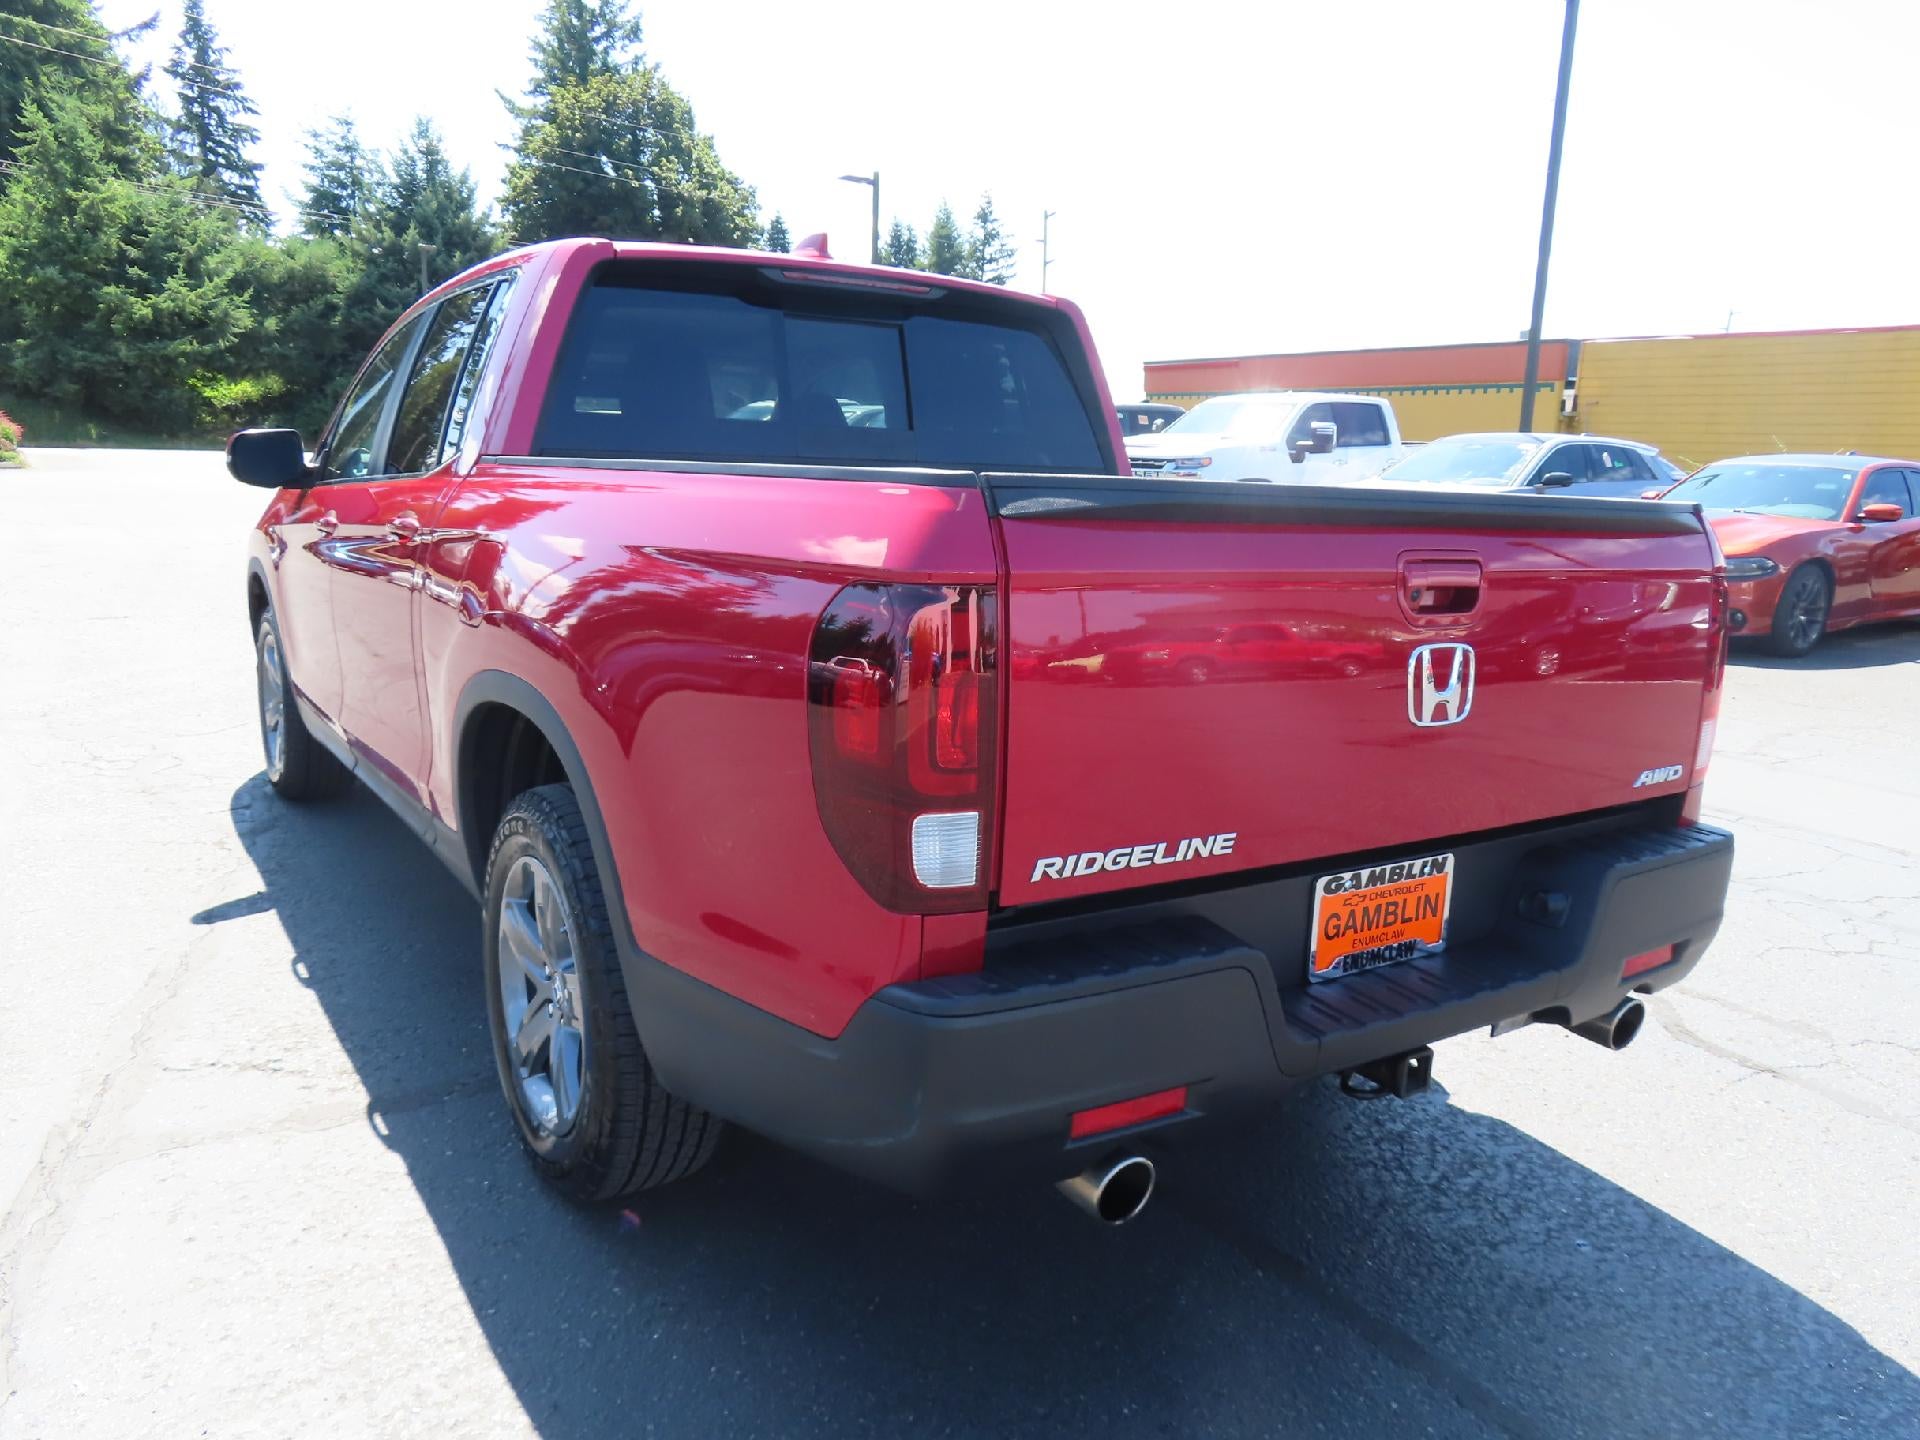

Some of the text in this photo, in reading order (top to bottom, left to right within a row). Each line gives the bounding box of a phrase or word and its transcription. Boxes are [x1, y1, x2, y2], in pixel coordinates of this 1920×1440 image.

[1632, 764, 1682, 788] AWD
[1030, 832, 1237, 883] RIDGELINE
[1323, 855, 1449, 895] GAMBLIN
[1369, 882, 1427, 901] CHEVROLET
[1324, 892, 1440, 940] GAMBLIN
[1352, 928, 1406, 949] ENUMCLAW
[1342, 939, 1417, 973] ENUMCLAW
